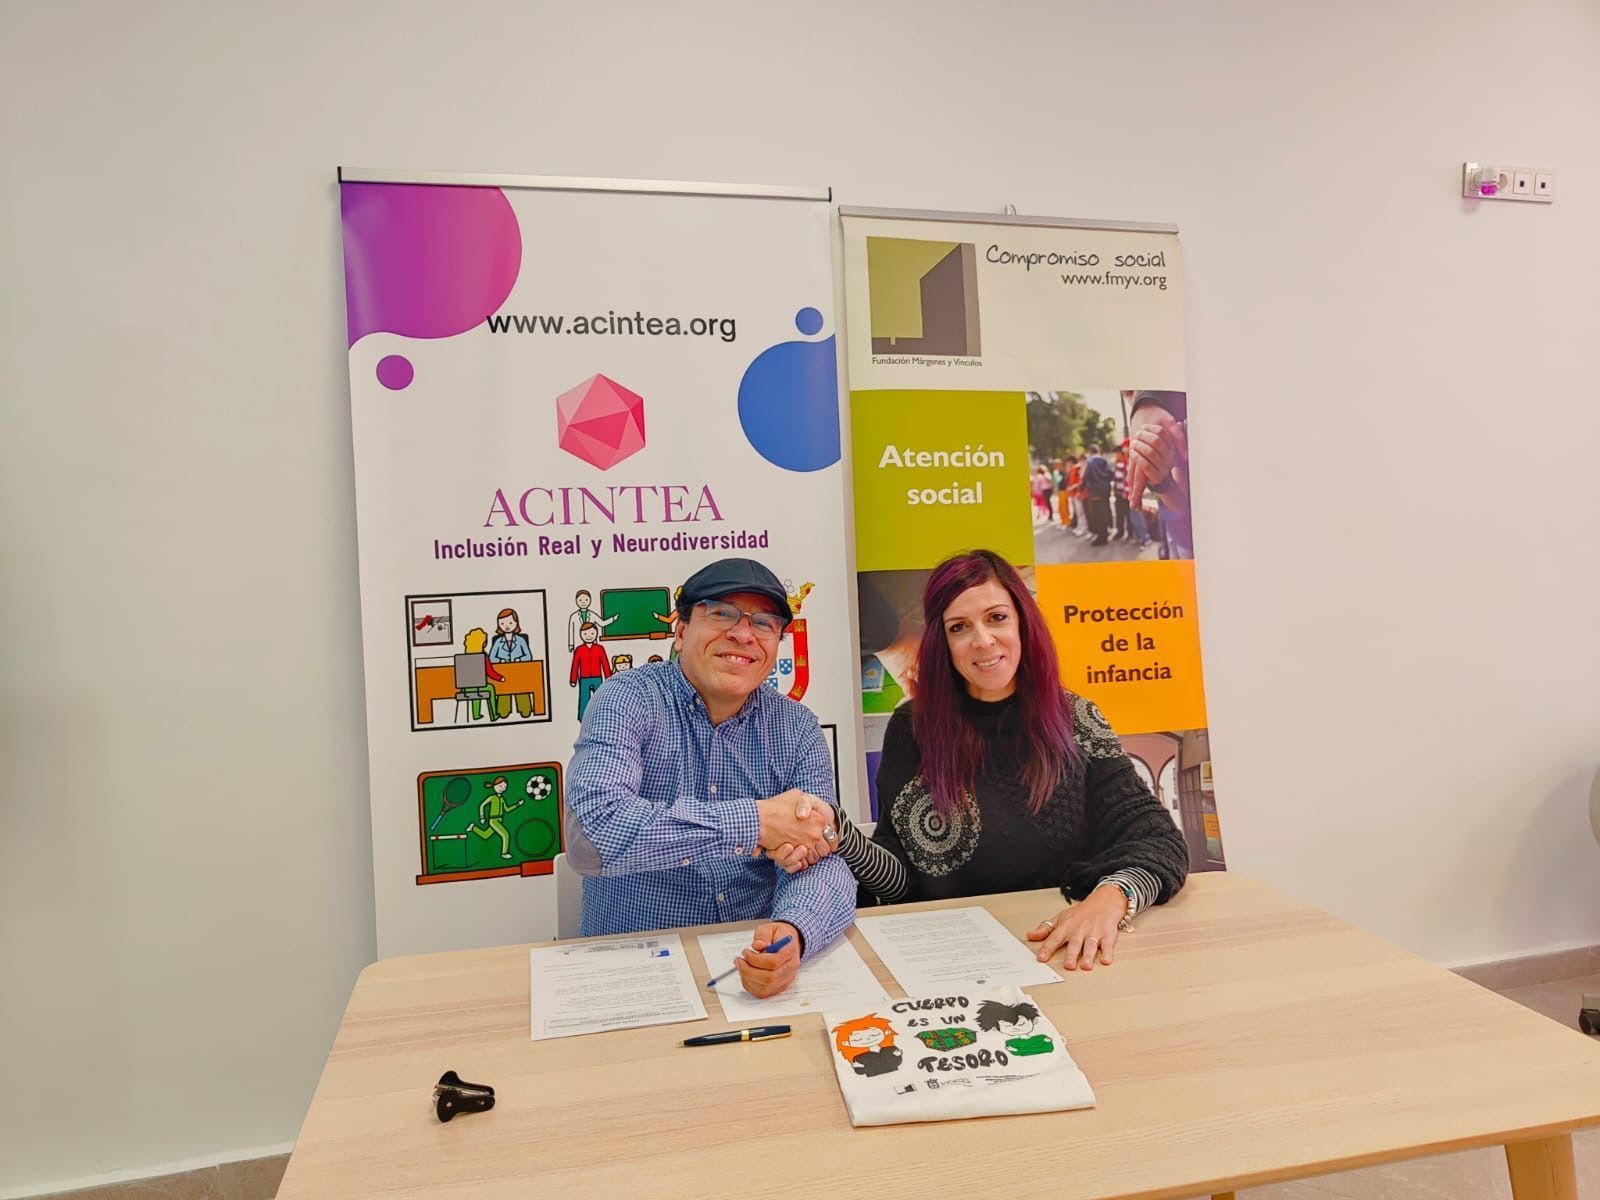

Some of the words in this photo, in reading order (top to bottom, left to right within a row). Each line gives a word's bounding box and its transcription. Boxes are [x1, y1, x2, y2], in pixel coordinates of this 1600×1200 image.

[985, 244, 1100, 272] Compromiso
[1114, 251, 1166, 268] social
[1061, 271, 1168, 291] www.fmyv.org
[486, 311, 737, 342] www.acintea.org
[872, 356, 911, 366] Fundación
[878, 444, 1006, 469] Atención
[483, 484, 725, 528] ACINTEA
[907, 481, 984, 506] social
[434, 536, 528, 560] Inclusión
[538, 534, 581, 556] Real
[591, 539, 602, 559] y
[612, 530, 769, 554] Neurodiversidad
[1063, 601, 1184, 624] Protección
[1101, 634, 1129, 652] de
[1136, 632, 1156, 650] la
[1086, 662, 1173, 684] infancia
